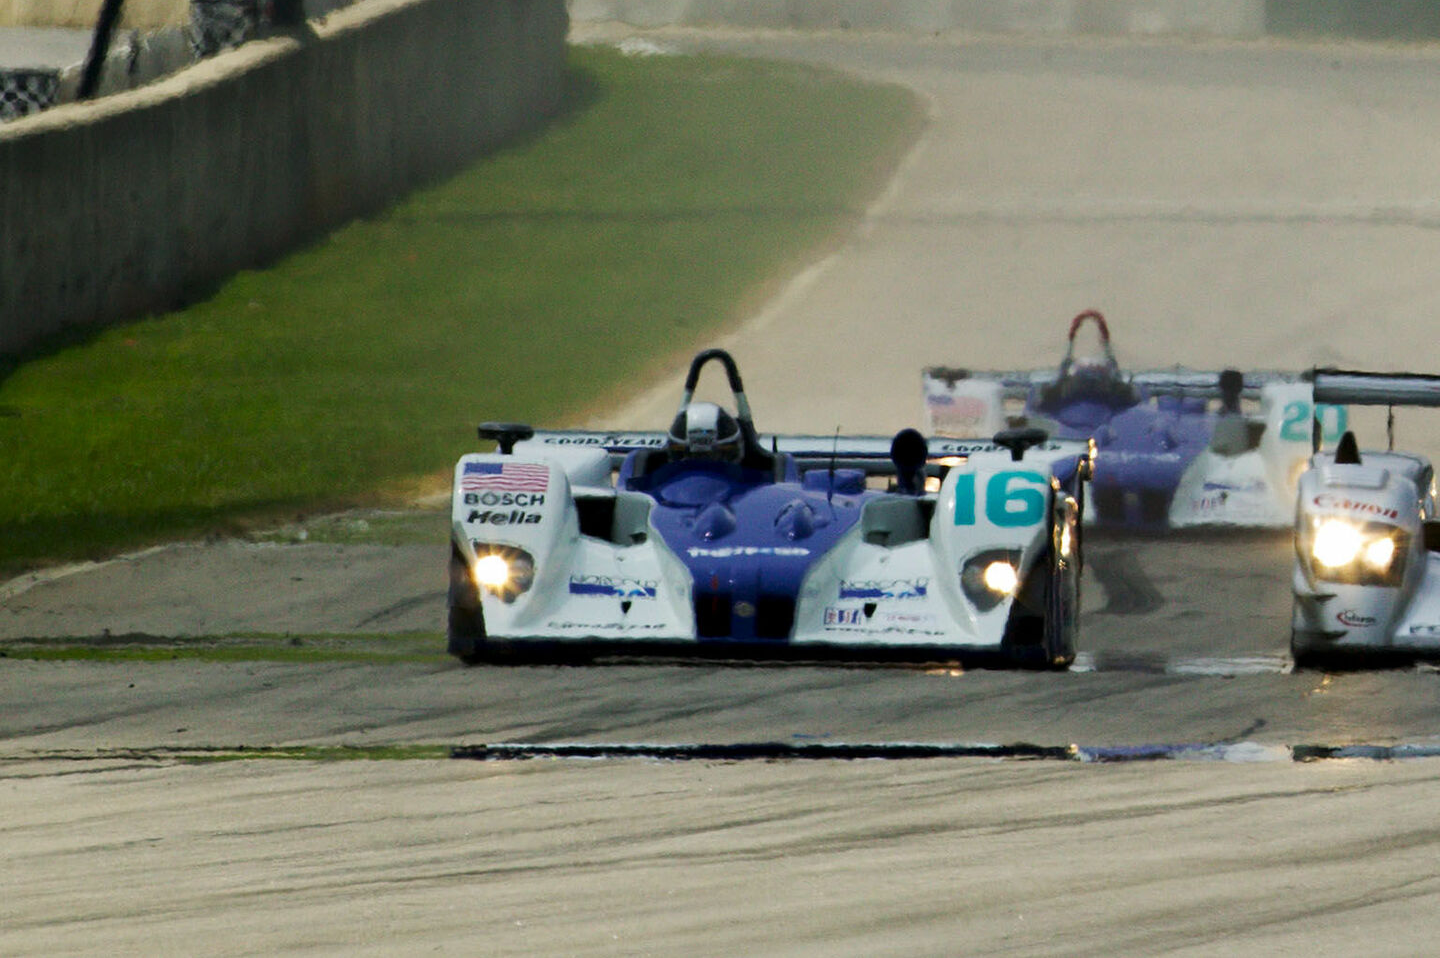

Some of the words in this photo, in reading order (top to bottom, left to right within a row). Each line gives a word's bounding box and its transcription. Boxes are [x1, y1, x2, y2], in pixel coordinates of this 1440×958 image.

[1279, 400, 1349, 442] 20
[463, 492, 545, 506] BOSCH
[954, 471, 1046, 527] 16
[1313, 493, 1399, 519] Canon
